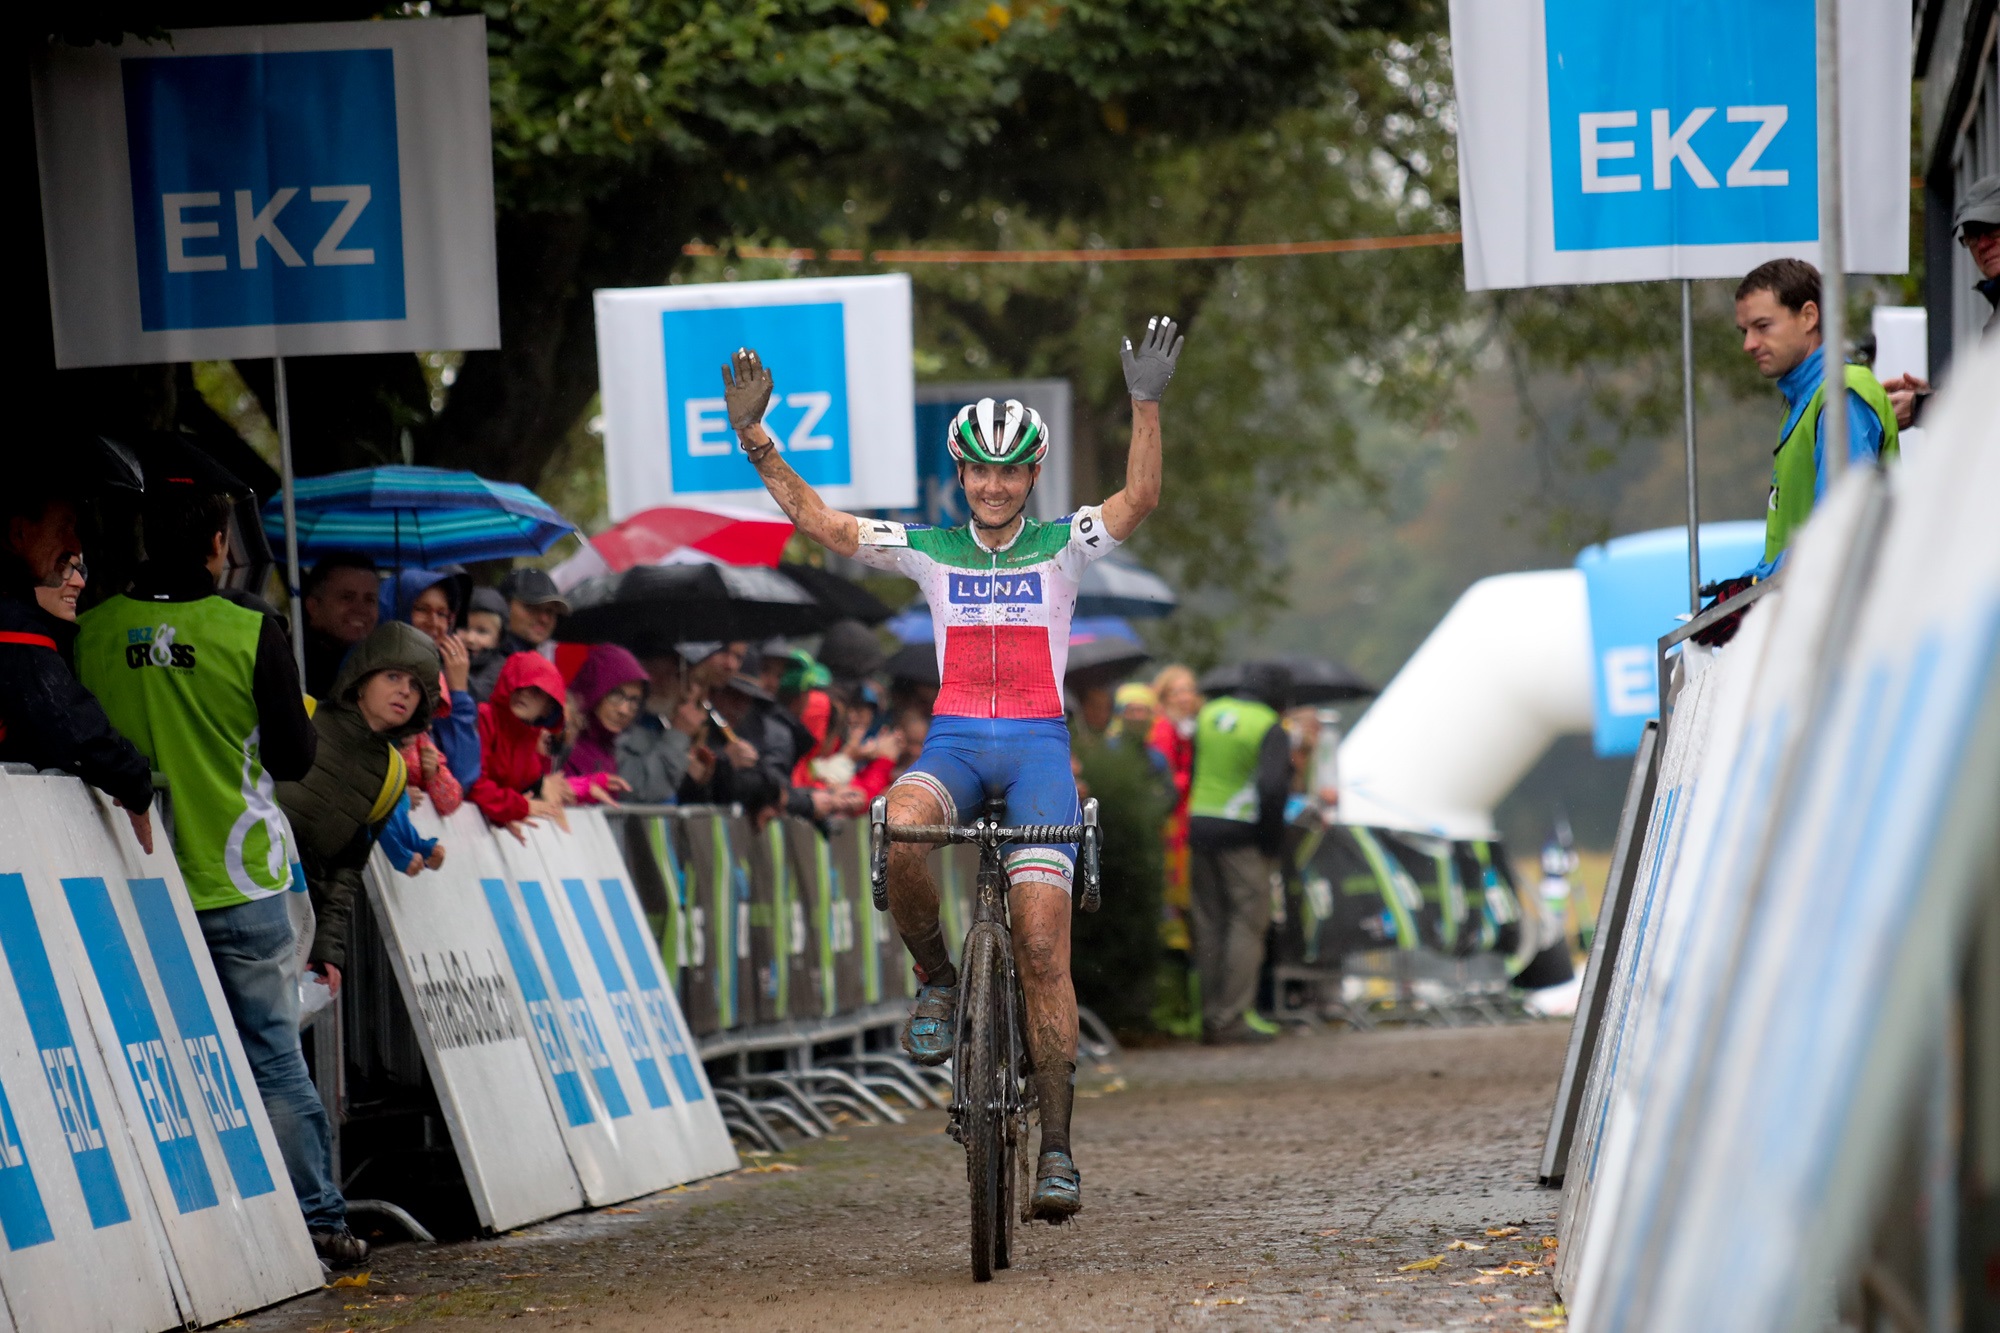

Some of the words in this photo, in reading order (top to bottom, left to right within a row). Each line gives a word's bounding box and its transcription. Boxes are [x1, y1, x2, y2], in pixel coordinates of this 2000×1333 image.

[1579, 104, 1789, 193] EKZ
[162, 184, 375, 273] EKZ
[957, 580, 1035, 598] LUNA
[126, 642, 196, 669] CROSS
[128, 626, 153, 644] EKZ
[42, 1047, 104, 1153] EKZ
[126, 1040, 192, 1142] EKZ
[185, 1035, 248, 1132] EKZ
